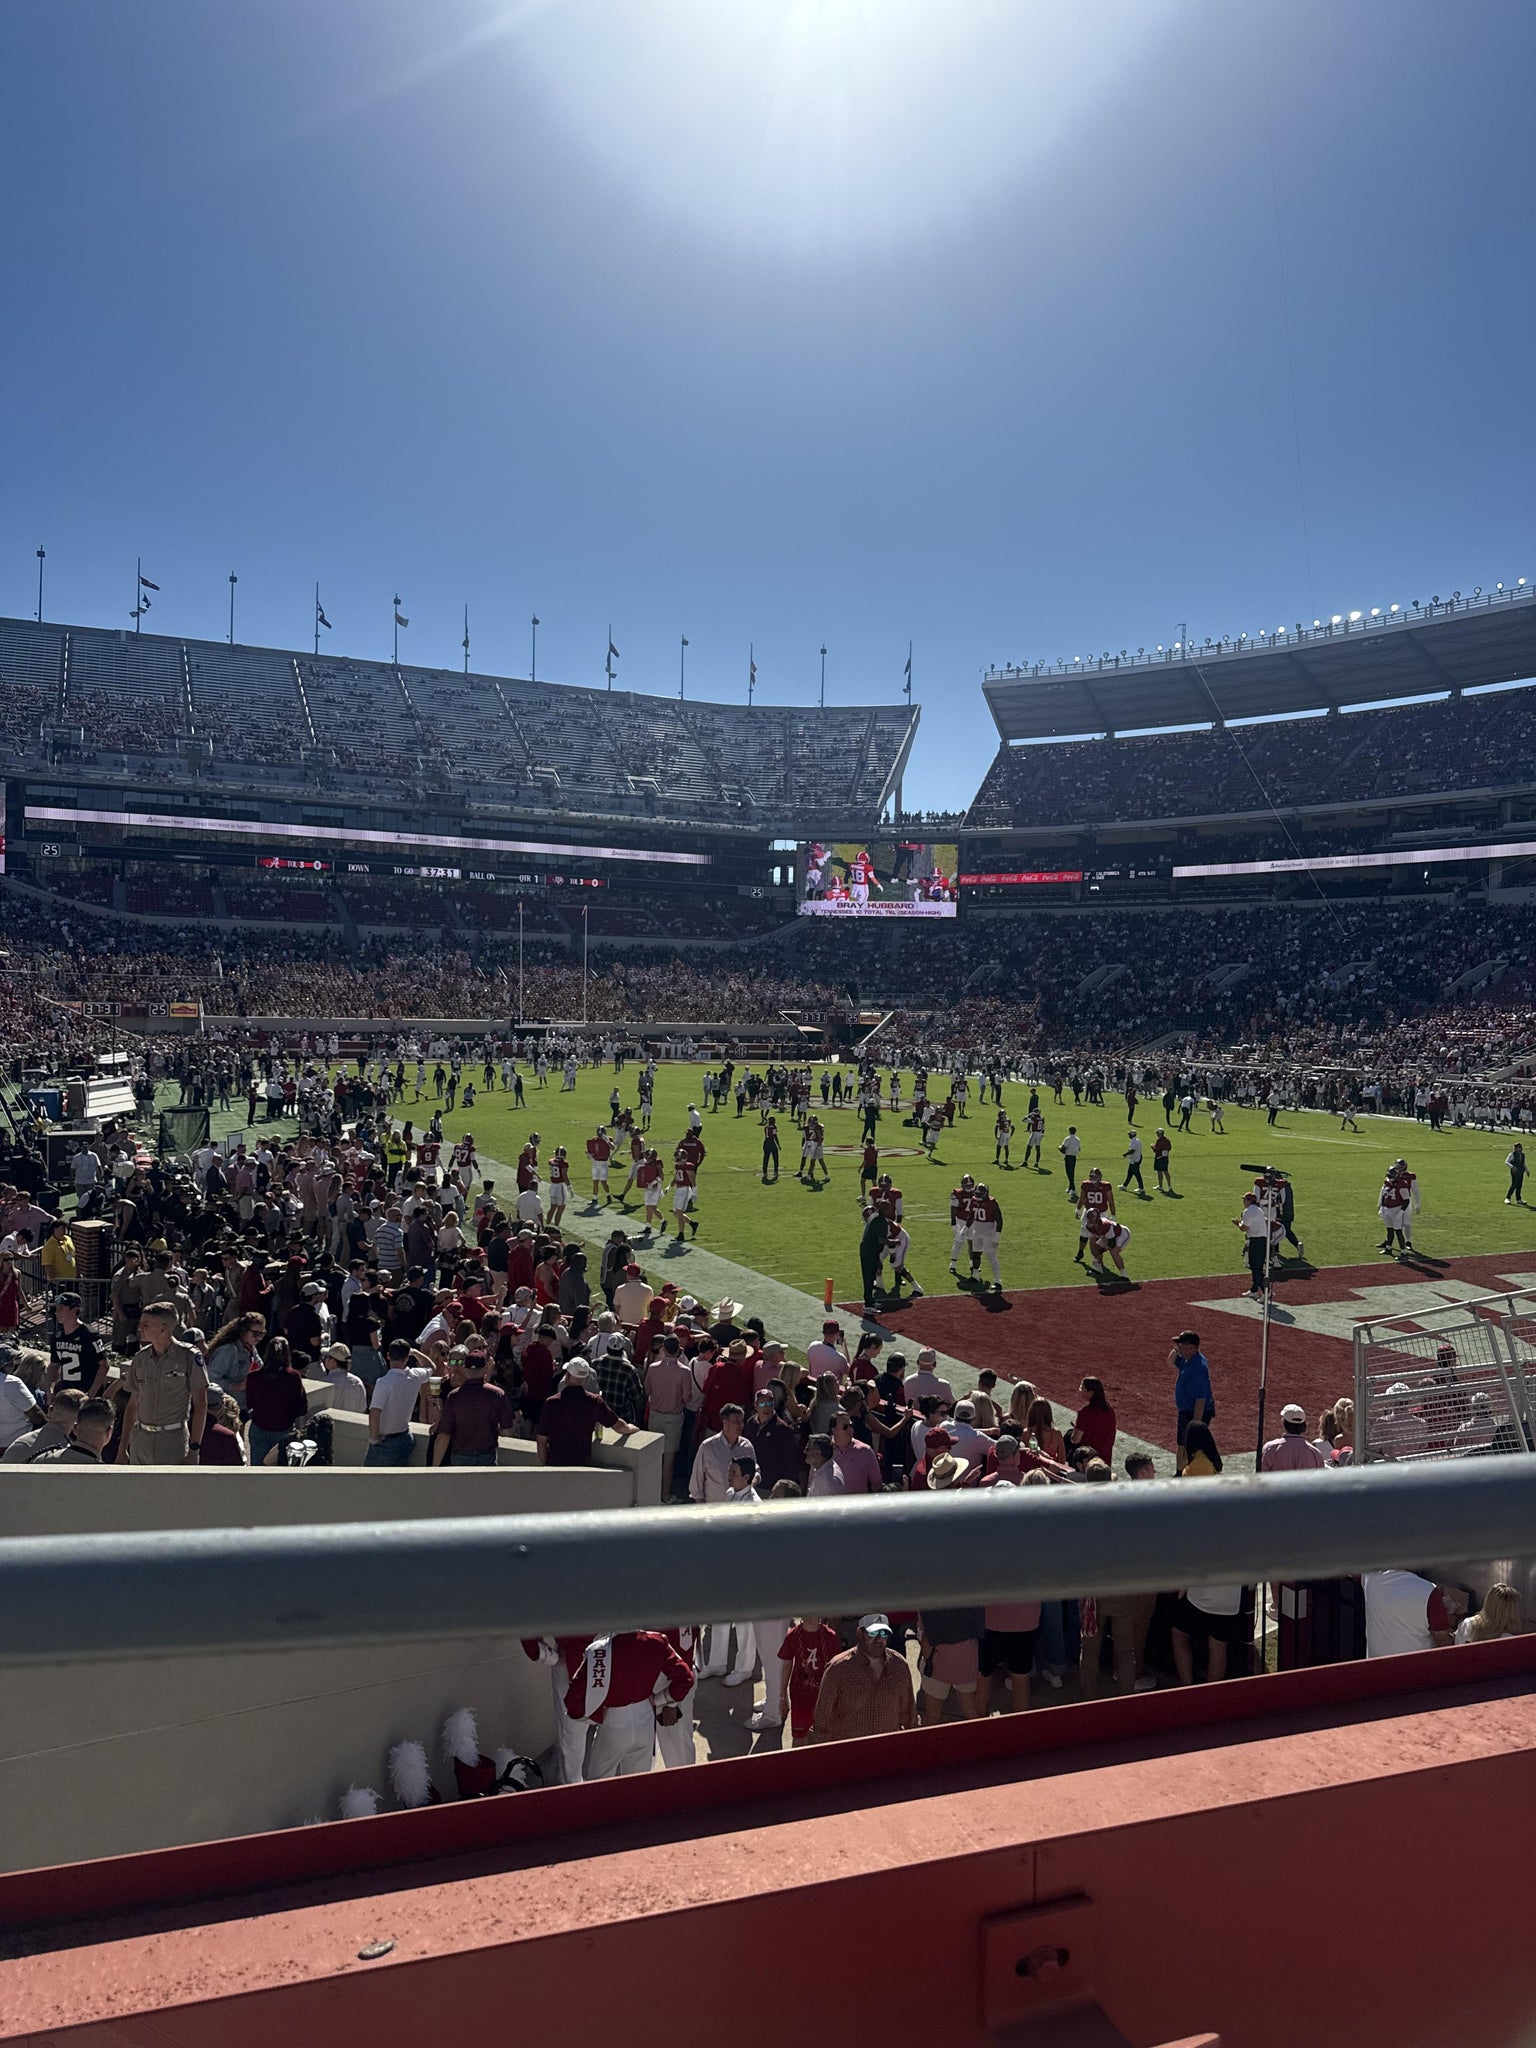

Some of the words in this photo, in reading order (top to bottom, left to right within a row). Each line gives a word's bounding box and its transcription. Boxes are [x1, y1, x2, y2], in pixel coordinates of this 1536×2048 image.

[43, 845, 58, 855] 25
[313, 860, 322, 870] 0
[347, 863, 370, 873] DOWN
[393, 866, 402, 874] TO
[403, 867, 414, 875] GO
[426, 868, 454, 877] 37:31
[469, 871, 485, 879] BALL
[486, 872, 496, 880] ON
[519, 874, 531, 882] QTR
[534, 874, 539, 884] 1
[591, 878, 599, 887] 0
[751, 888, 762, 898] 25
[87, 1004, 119, 1014] 37:31
[152, 1004, 166, 1015] 25
[804, 1013, 826, 1022] 37:31
[847, 1013, 858, 1022] 25
[1087, 1191, 1103, 1204] 50
[1261, 1186, 1279, 1200] 75
[972, 1207, 986, 1221] 70
[91, 1338, 105, 1354] 12
[806, 1647, 819, 1671] A
[591, 1649, 607, 1688] BAMA
